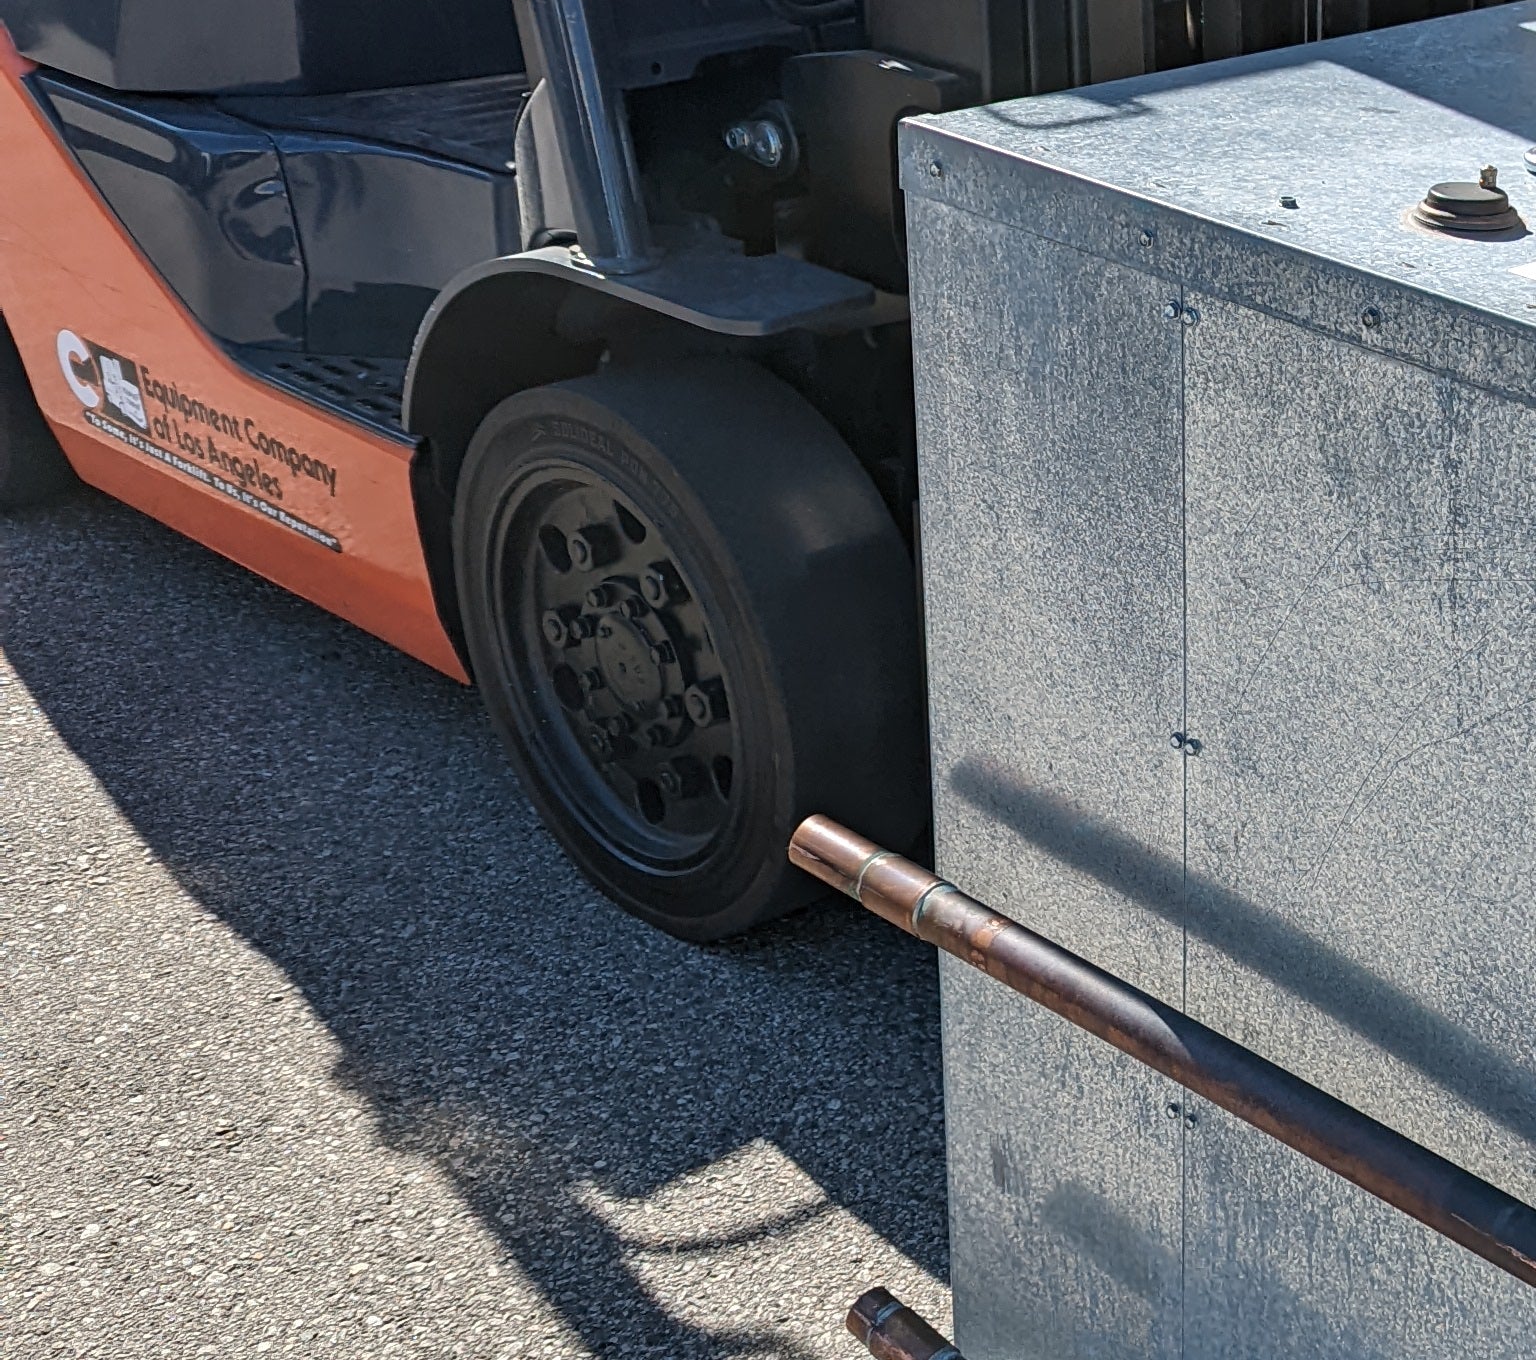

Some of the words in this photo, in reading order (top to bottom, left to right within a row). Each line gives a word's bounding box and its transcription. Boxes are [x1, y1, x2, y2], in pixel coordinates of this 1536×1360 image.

[140, 364, 243, 442] Equipment
[244, 417, 337, 495] Company
[153, 413, 172, 443] of
[173, 418, 205, 460] Los
[207, 434, 283, 500] Angeles
